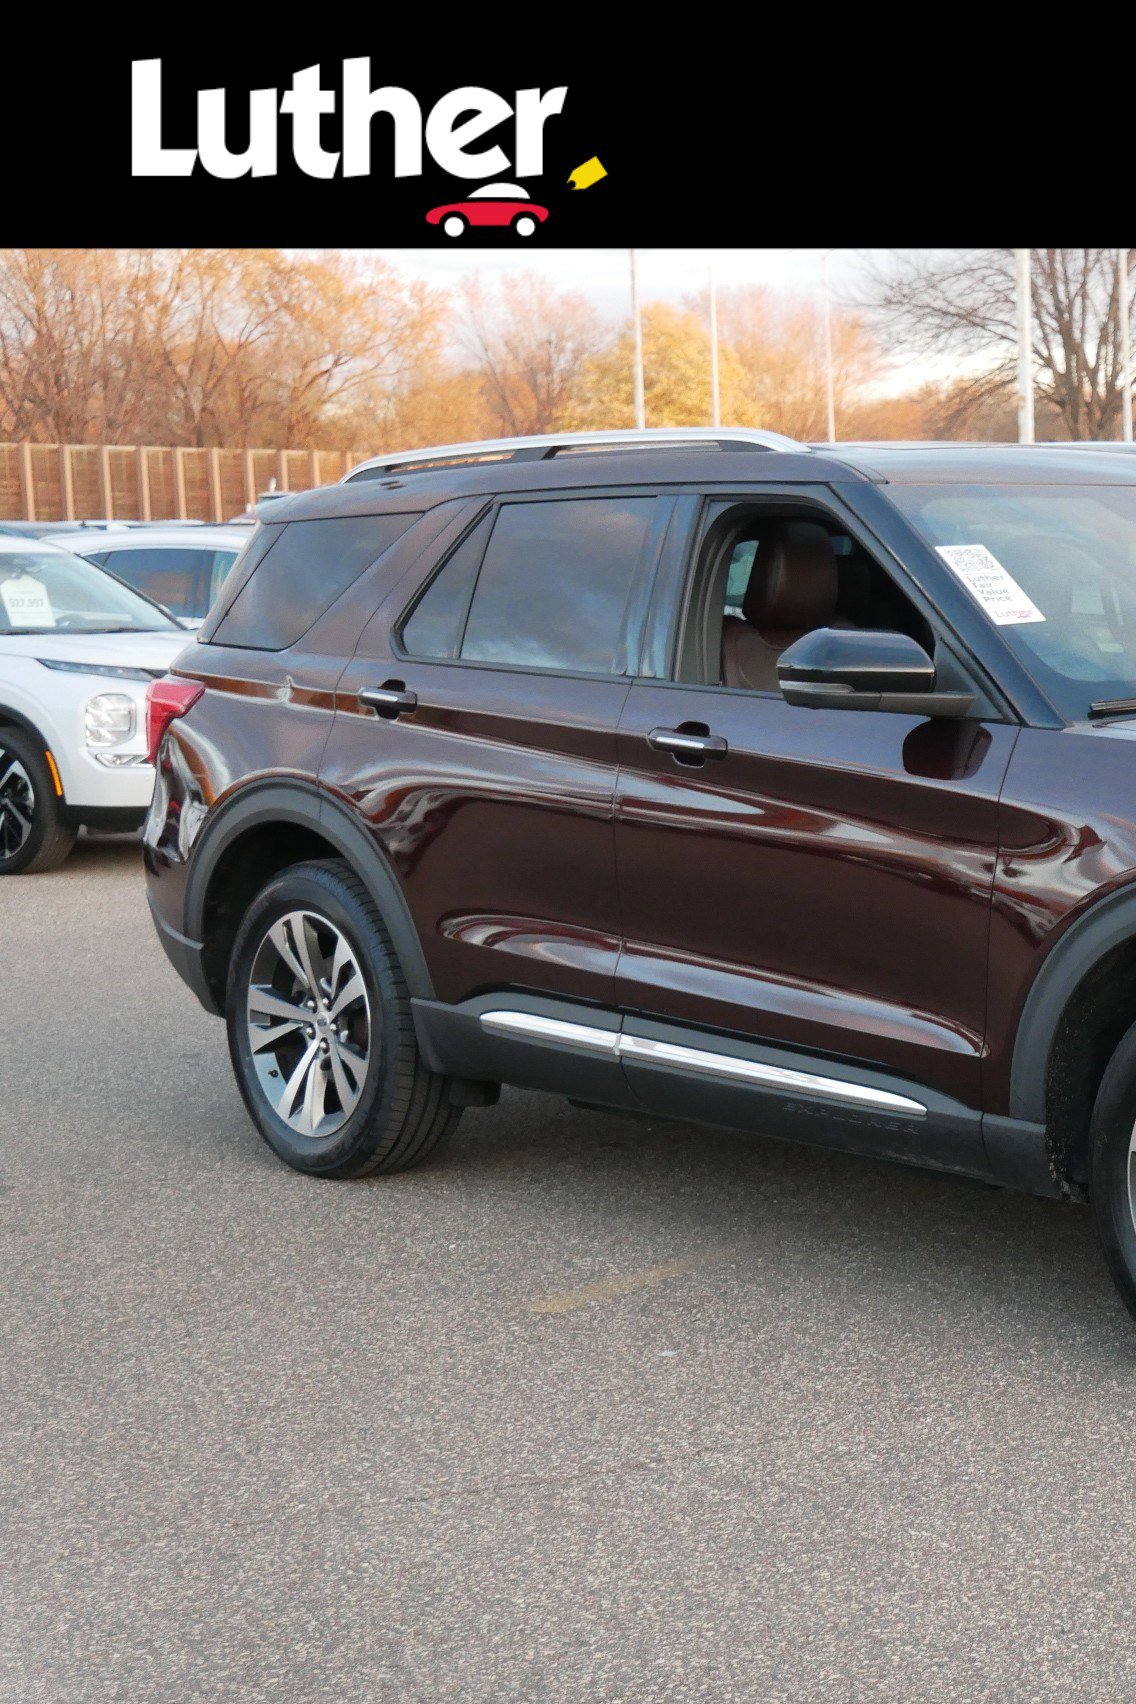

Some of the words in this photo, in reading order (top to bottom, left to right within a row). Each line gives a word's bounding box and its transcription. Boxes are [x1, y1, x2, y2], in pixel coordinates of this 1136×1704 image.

[966, 574, 1004, 583] Luther
[977, 588, 1010, 596] Value
[983, 595, 1013, 603] Price
